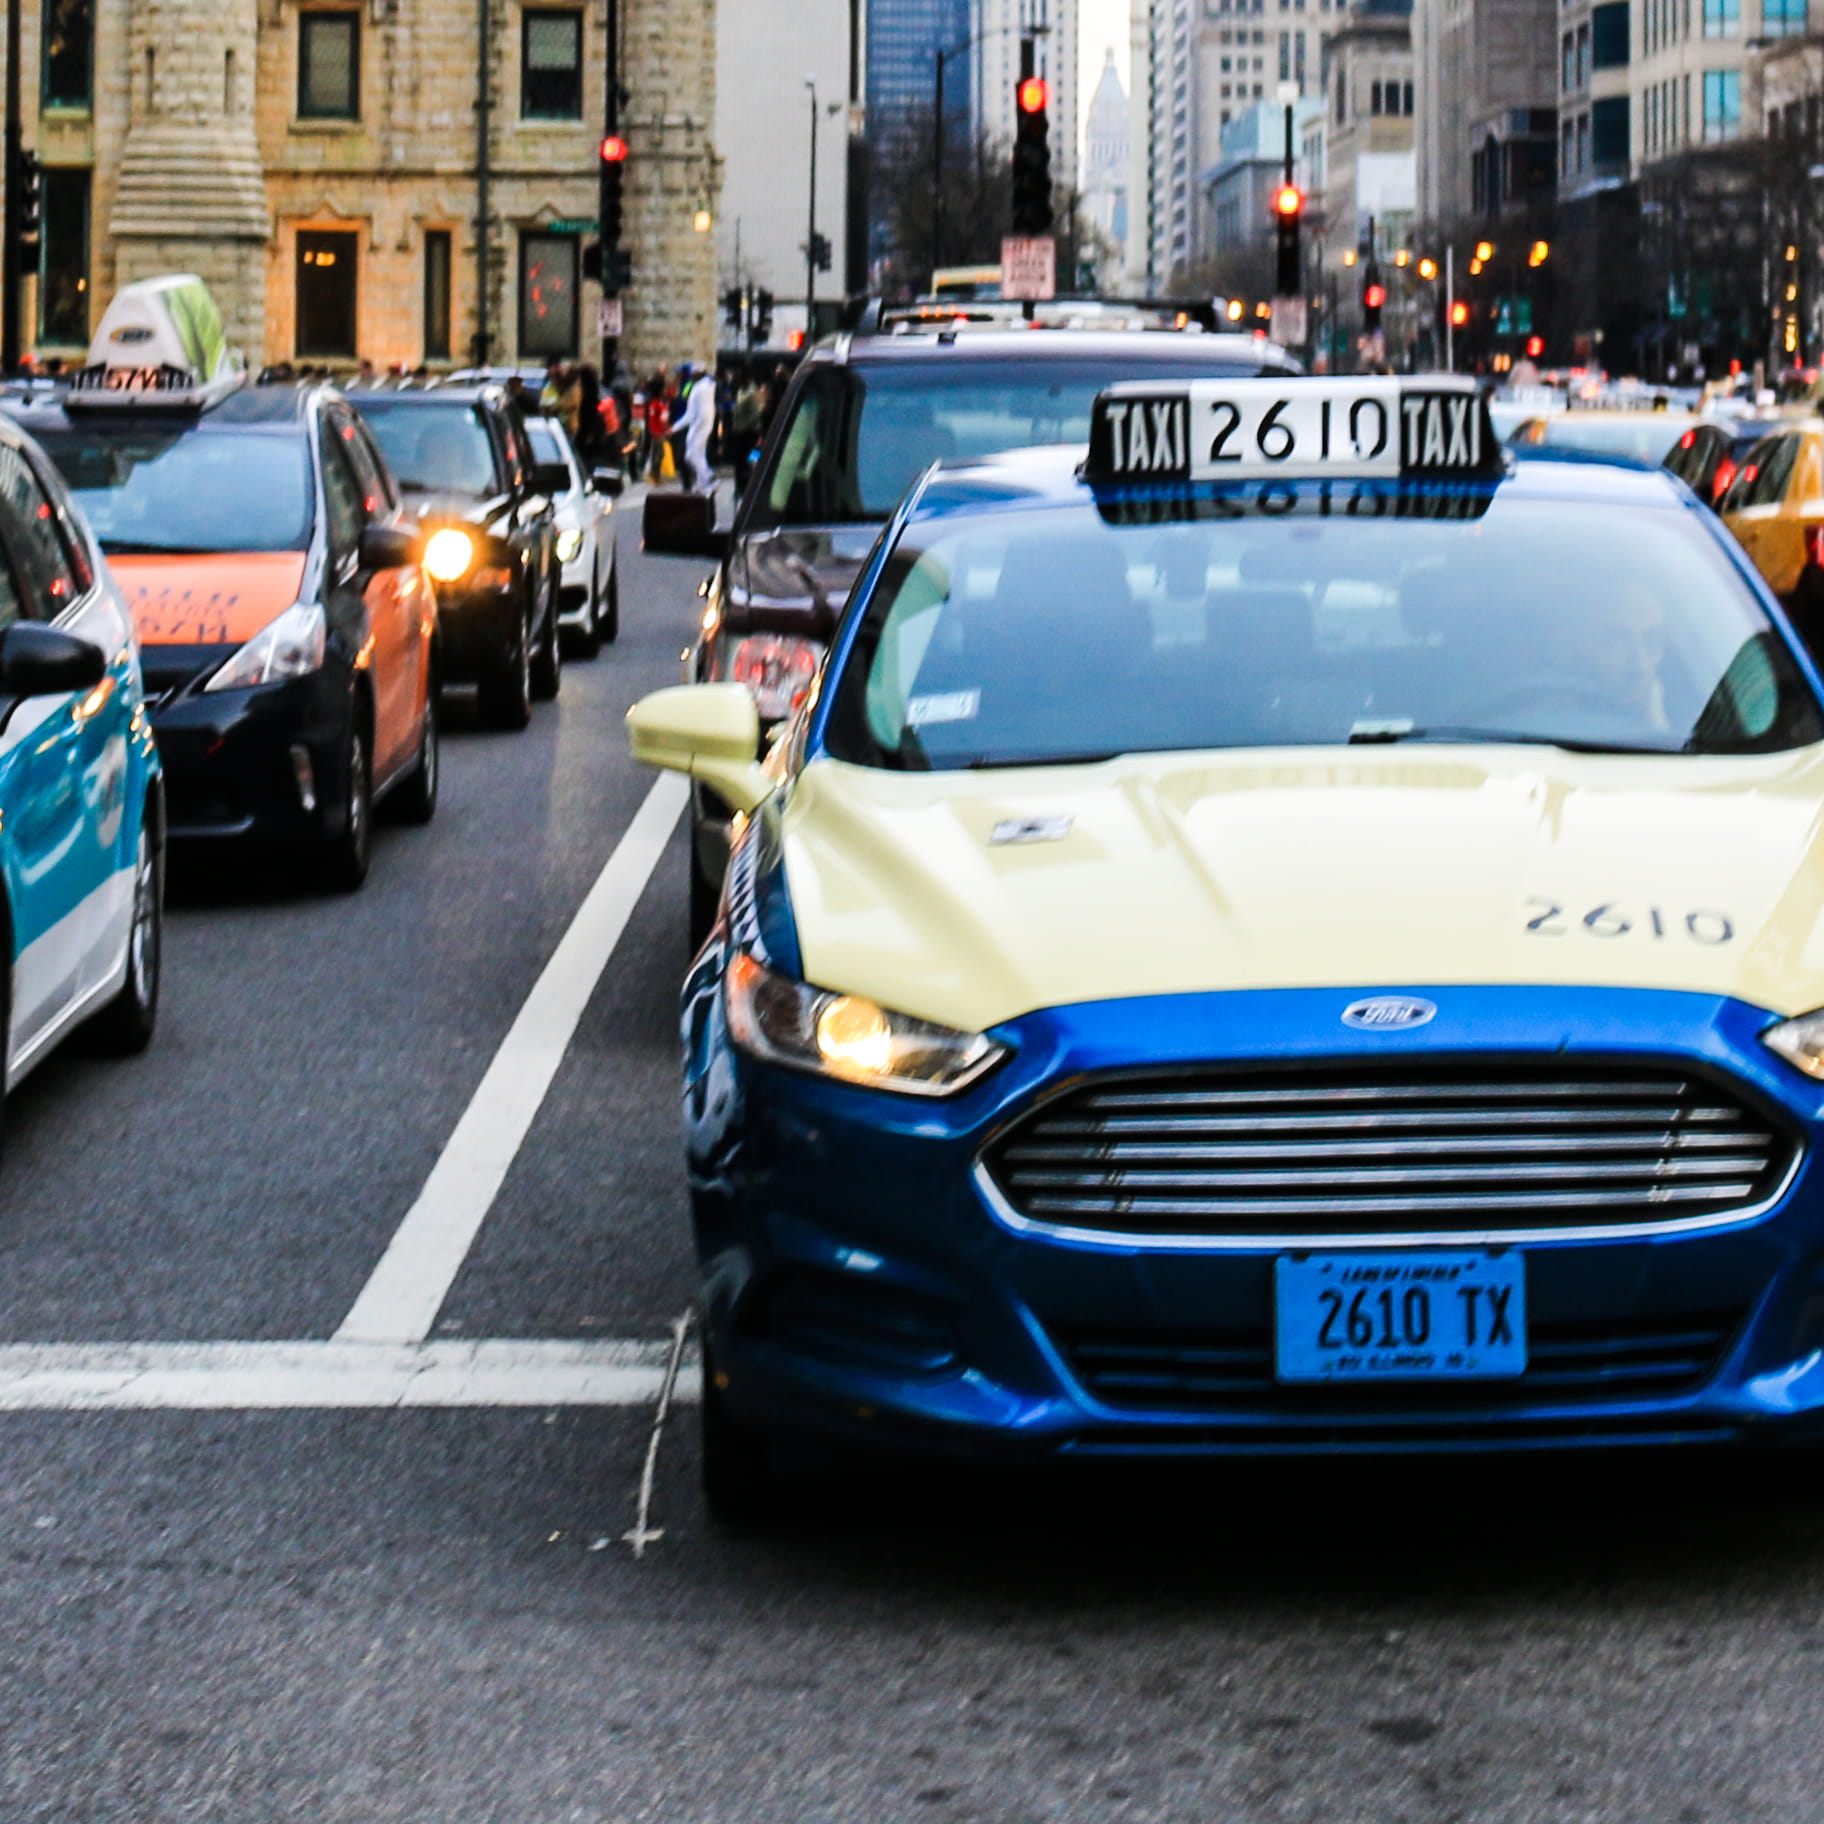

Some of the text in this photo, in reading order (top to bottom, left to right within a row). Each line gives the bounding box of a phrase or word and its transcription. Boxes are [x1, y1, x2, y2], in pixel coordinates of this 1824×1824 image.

[1106, 396, 1482, 472] TAXI 2610 TAXI
[1525, 896, 1734, 946] 2610
[1318, 1283, 1513, 1349] 2610 TX
